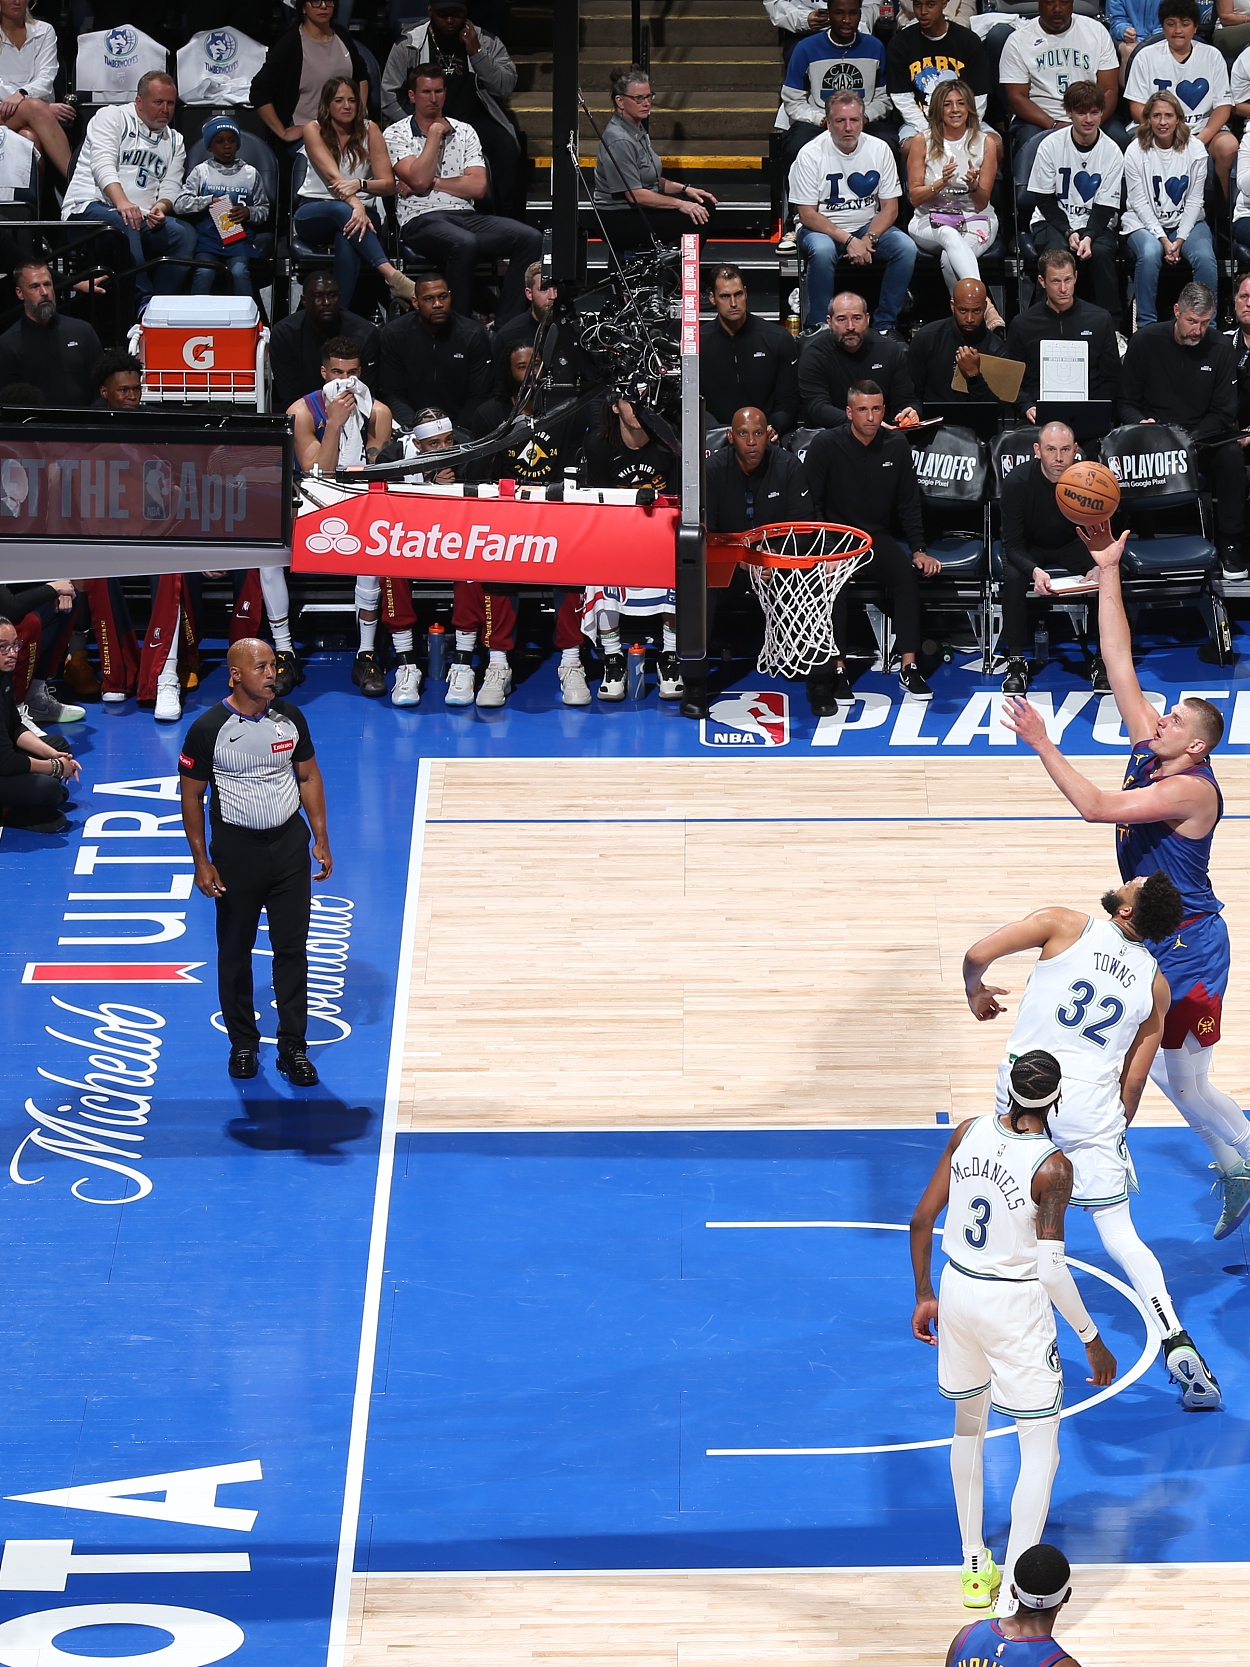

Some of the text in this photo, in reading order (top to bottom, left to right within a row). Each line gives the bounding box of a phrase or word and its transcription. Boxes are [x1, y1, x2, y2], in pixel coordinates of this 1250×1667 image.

[823, 63, 863, 85] ACTIVE
[909, 56, 965, 81] BABY
[1036, 48, 1090, 71] WOLVES
[1056, 73, 1069, 95] 5
[135, 168, 149, 189] 5
[207, 184, 248, 194] MINNESOTA
[824, 173, 846, 203] I
[182, 335, 215, 370] G
[1124, 450, 1189, 480] PLAYOFFS
[56, 459, 130, 519] THE
[176, 461, 247, 532] App
[1063, 488, 1104, 511] Wilson
[714, 733, 756, 744] NBA
[1093, 952, 1137, 989] TOWNS
[1055, 977, 1127, 1050] 32
[10, 995, 167, 1205] Michelob
[951, 1157, 1026, 1211] McDANIELS
[963, 1195, 993, 1251] 3
